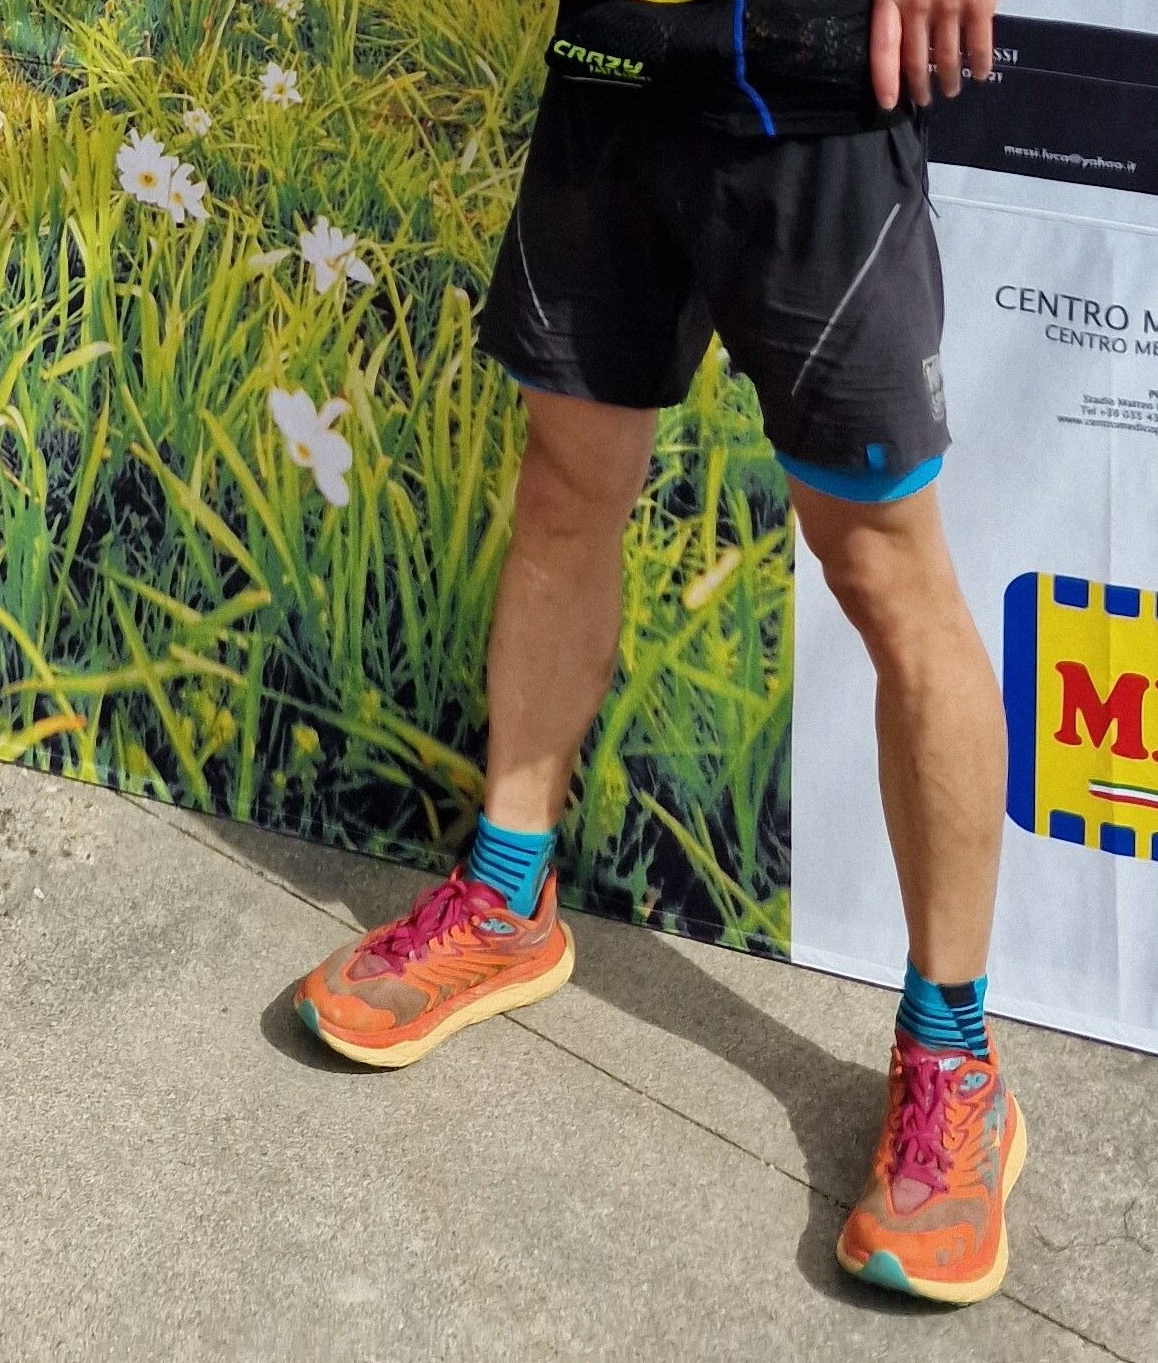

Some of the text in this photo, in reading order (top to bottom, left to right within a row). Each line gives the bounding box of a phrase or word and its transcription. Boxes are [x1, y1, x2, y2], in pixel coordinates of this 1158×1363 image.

[553, 39, 644, 75] CRAZY
[995, 285, 1129, 331] CENTRO
[1045, 324, 1127, 354] CENTRO
[1054, 660, 1158, 762] M
